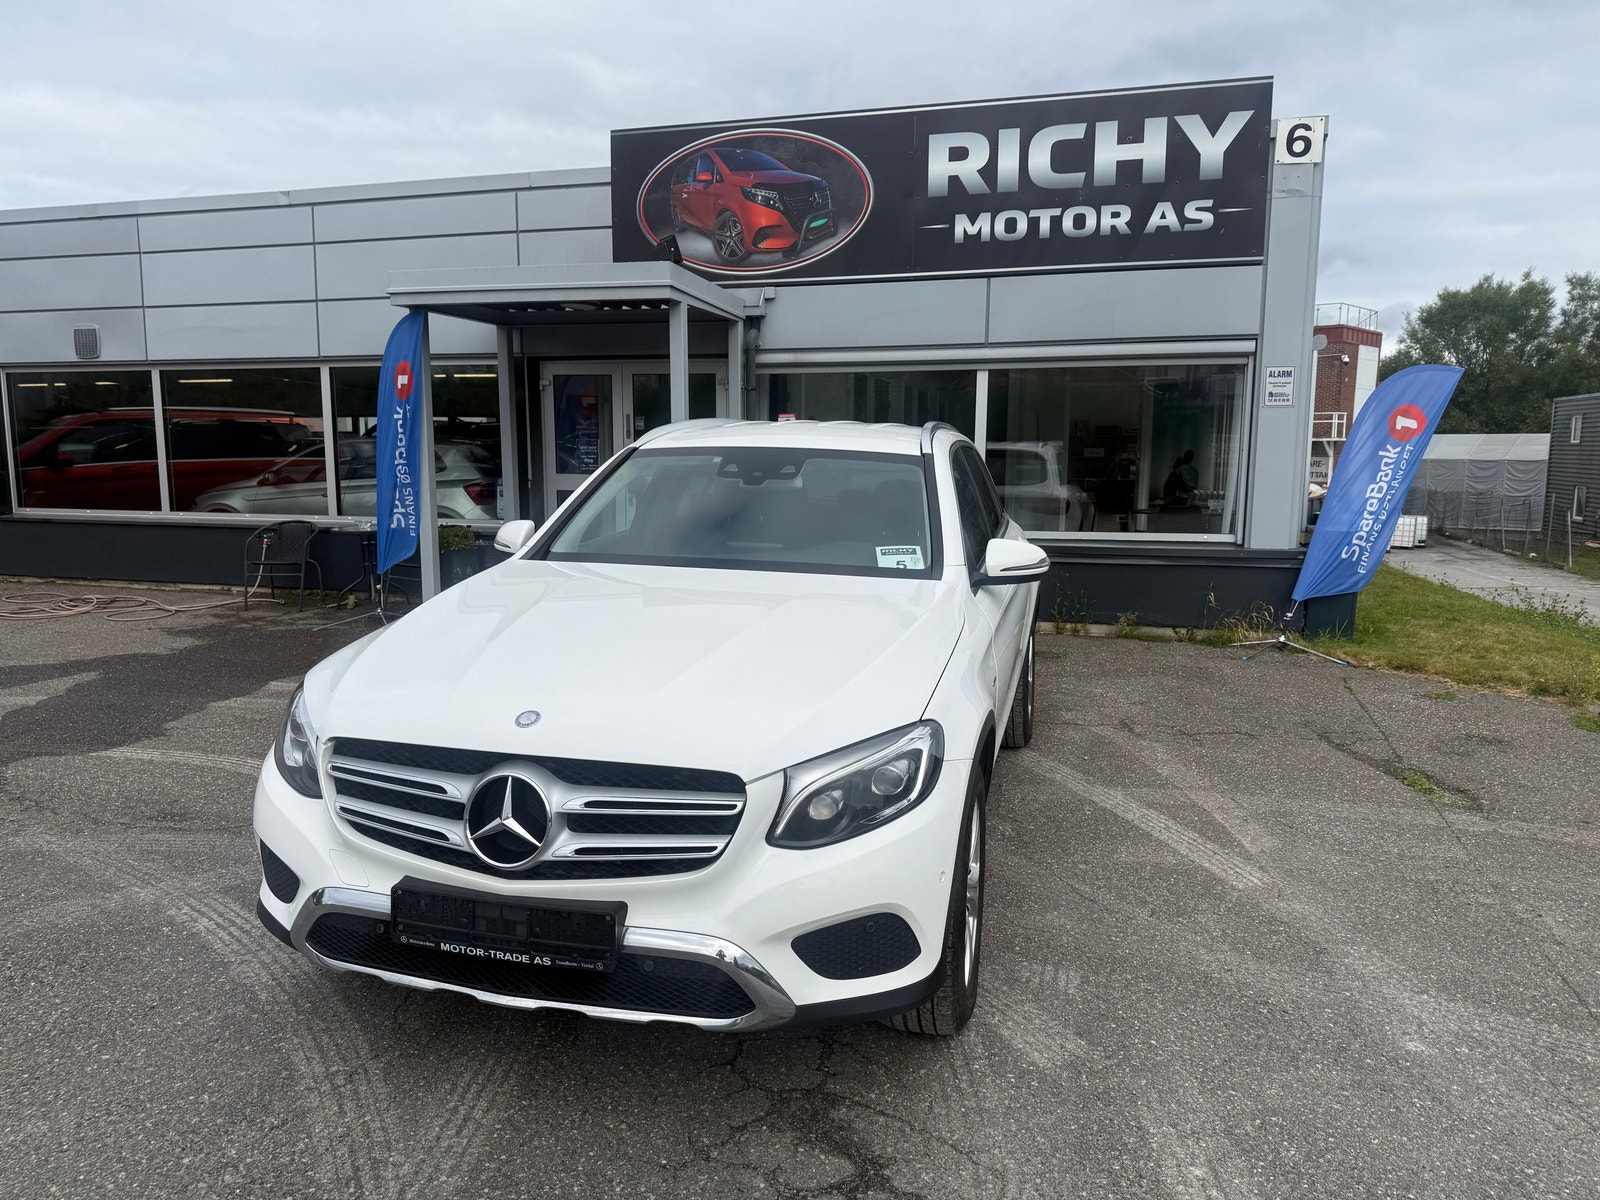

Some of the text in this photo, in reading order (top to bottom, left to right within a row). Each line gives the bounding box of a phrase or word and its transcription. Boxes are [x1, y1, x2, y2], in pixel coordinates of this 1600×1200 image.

[927, 109, 1255, 197] RICHY
[1285, 123, 1312, 158] 6
[954, 199, 1215, 244] MOTOR AS
[1268, 370, 1293, 378] ALARM
[1395, 415, 1418, 430] 1
[406, 486, 416, 537] FINANS
[1341, 443, 1402, 562] SpareBank
[1357, 521, 1383, 574] FINANS
[440, 942, 531, 964] MOTOR-TRADE
[533, 956, 552, 966] AS
